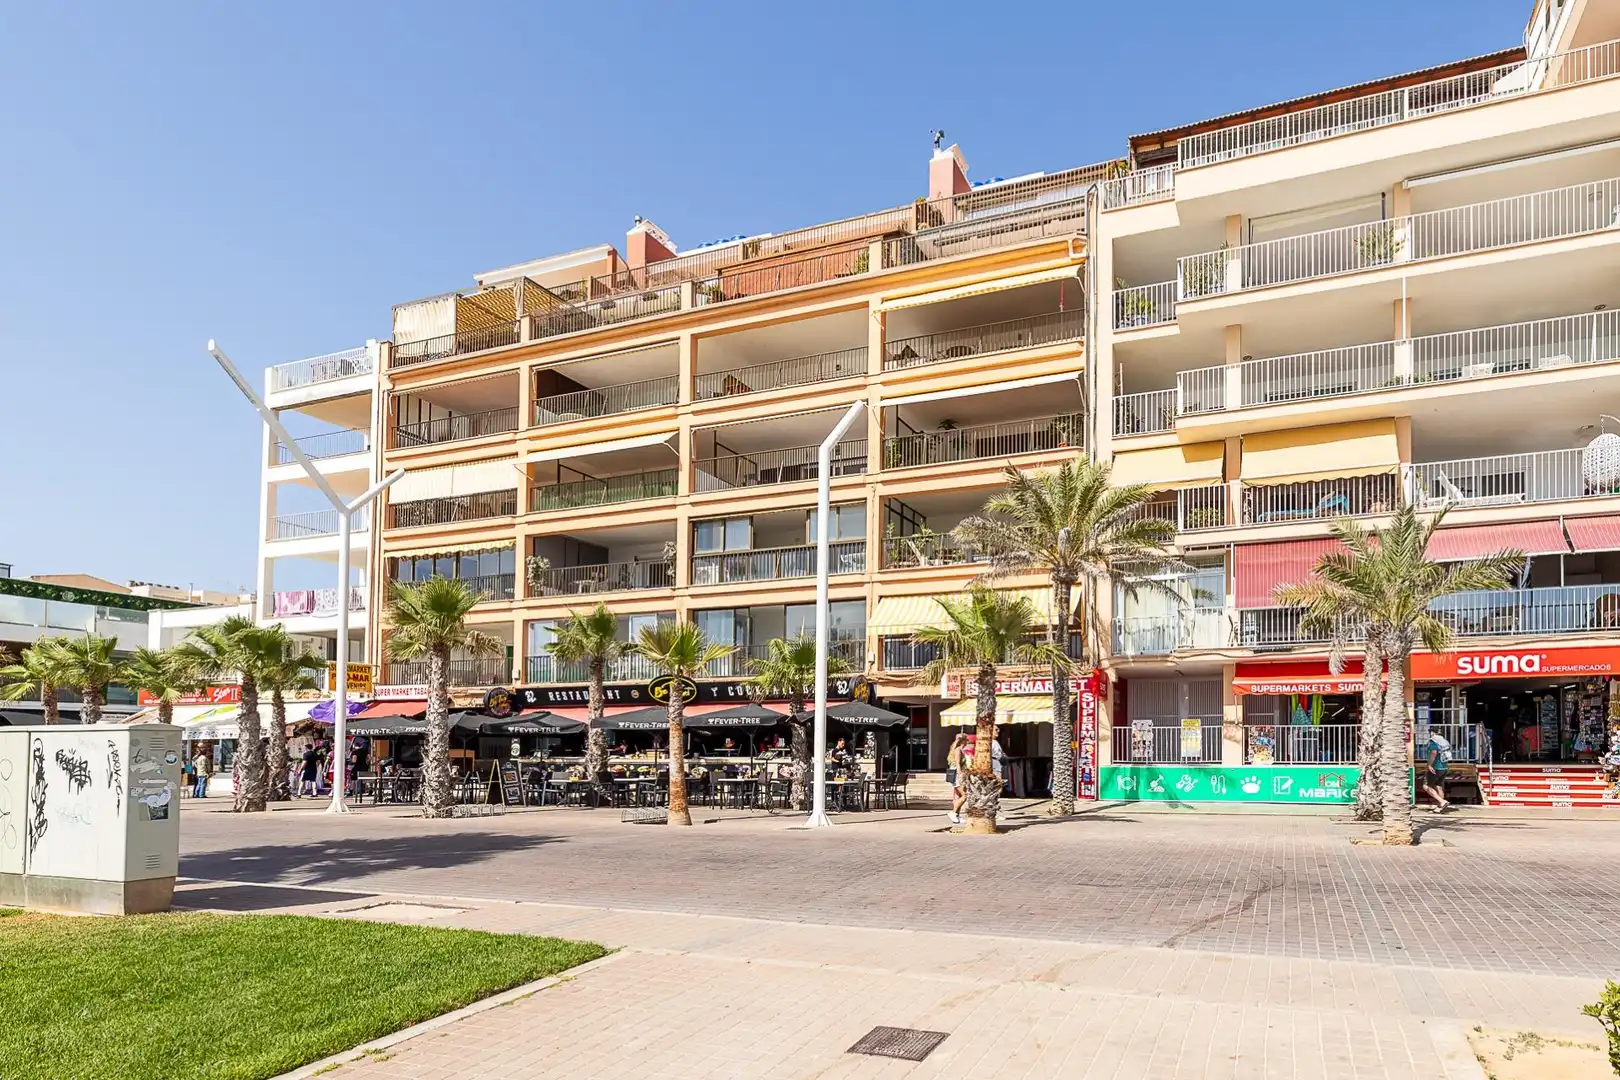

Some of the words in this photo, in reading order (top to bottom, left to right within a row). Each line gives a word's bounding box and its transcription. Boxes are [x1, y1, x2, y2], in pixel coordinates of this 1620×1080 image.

[1457, 654, 1540, 675] suma
[1542, 663, 1611, 672] SUPERMERCADOS
[375, 688, 391, 697] SUPER
[391, 688, 413, 696] MARKET
[1251, 684, 1331, 692] SUPERMARKETS
[548, 689, 620, 701] RESTAUNT
[714, 717, 761, 725] FEVER-TREE
